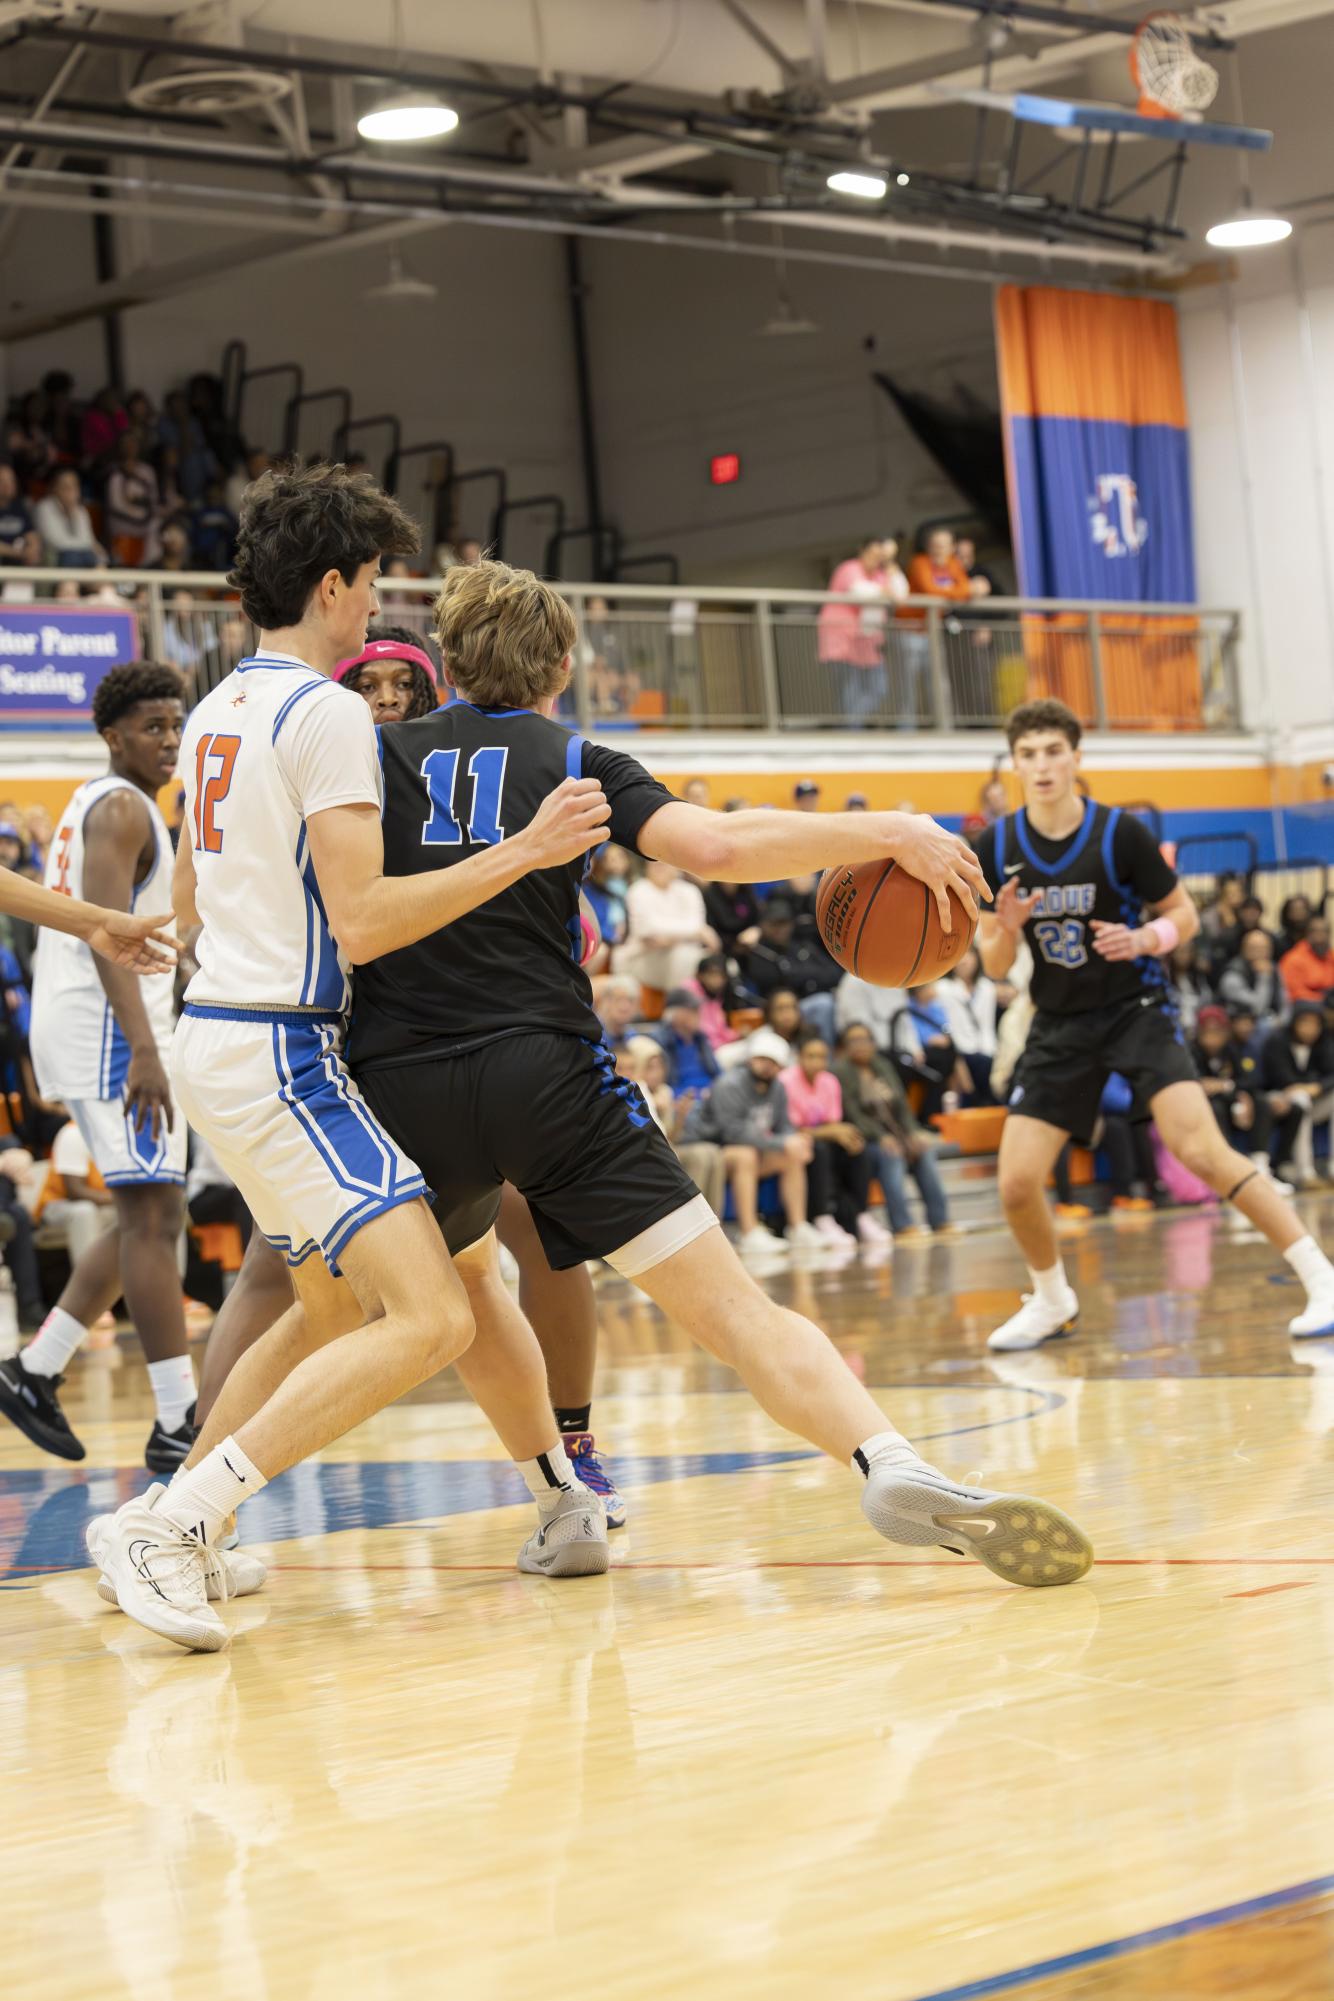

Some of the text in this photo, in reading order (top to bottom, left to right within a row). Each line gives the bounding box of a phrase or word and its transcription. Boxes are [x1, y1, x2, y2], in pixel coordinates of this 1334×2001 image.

[40, 625, 118, 657] Parent
[0, 663, 87, 703] Seating
[194, 733, 241, 854] 12
[420, 746, 509, 845] 11
[1033, 918, 1088, 969] 22
